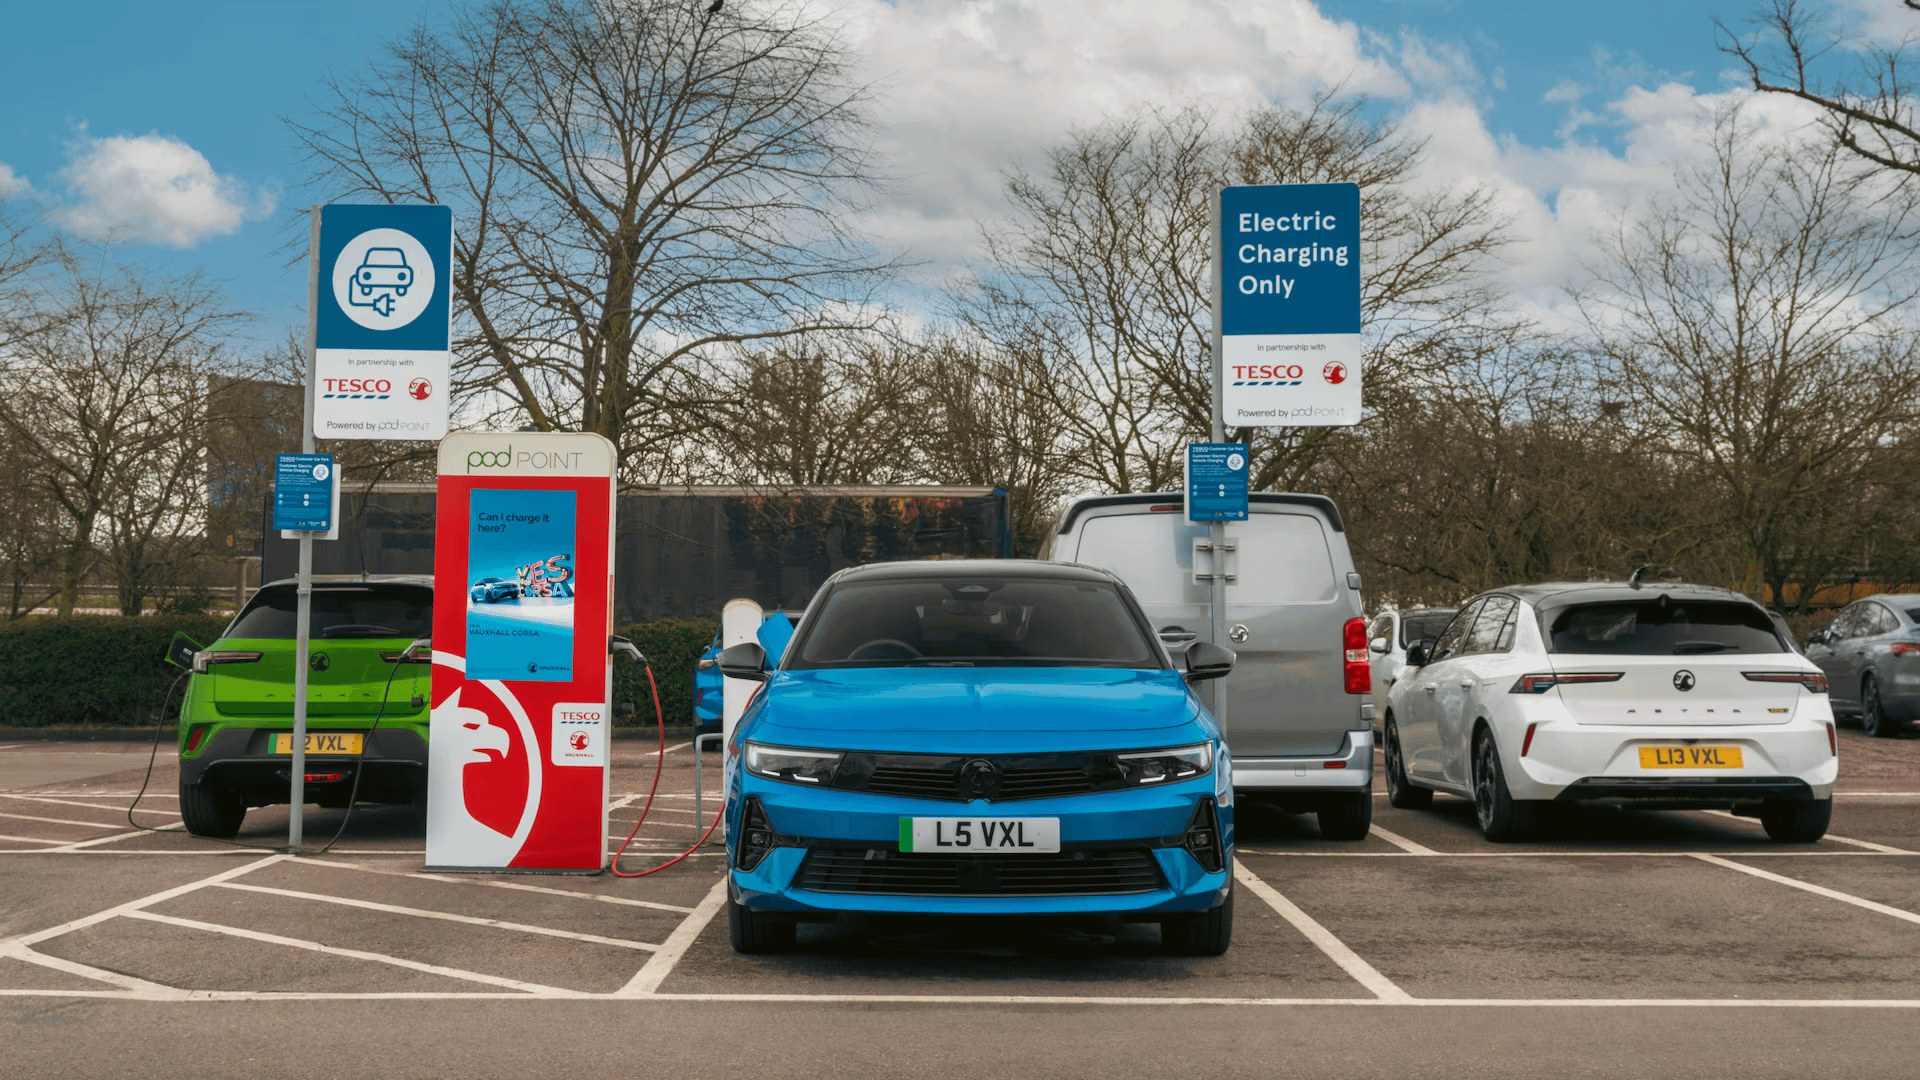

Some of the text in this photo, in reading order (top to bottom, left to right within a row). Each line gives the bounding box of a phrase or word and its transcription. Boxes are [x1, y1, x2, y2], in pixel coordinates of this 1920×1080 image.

[1239, 211, 1336, 232] Electric
[1238, 242, 1349, 267] Charging
[1238, 275, 1295, 299] Only
[1266, 344, 1308, 352] partnership
[356, 358, 397, 367] partnership
[1232, 365, 1304, 379] TESCO
[323, 378, 392, 393] TESCO
[1237, 405, 1345, 419] Powered by pod POINT
[327, 419, 431, 432] Powered by pod POINT
[467, 444, 584, 474] pod POINT
[478, 512, 550, 524] Can I charge it
[477, 523, 507, 532] here?
[515, 553, 573, 586] YES
[520, 582, 569, 597] CORSA
[560, 711, 601, 721] TESCO
[317, 735, 347, 751] VXL
[1656, 748, 1726, 765] L13 VXL
[936, 821, 1034, 847] L5 VXL
